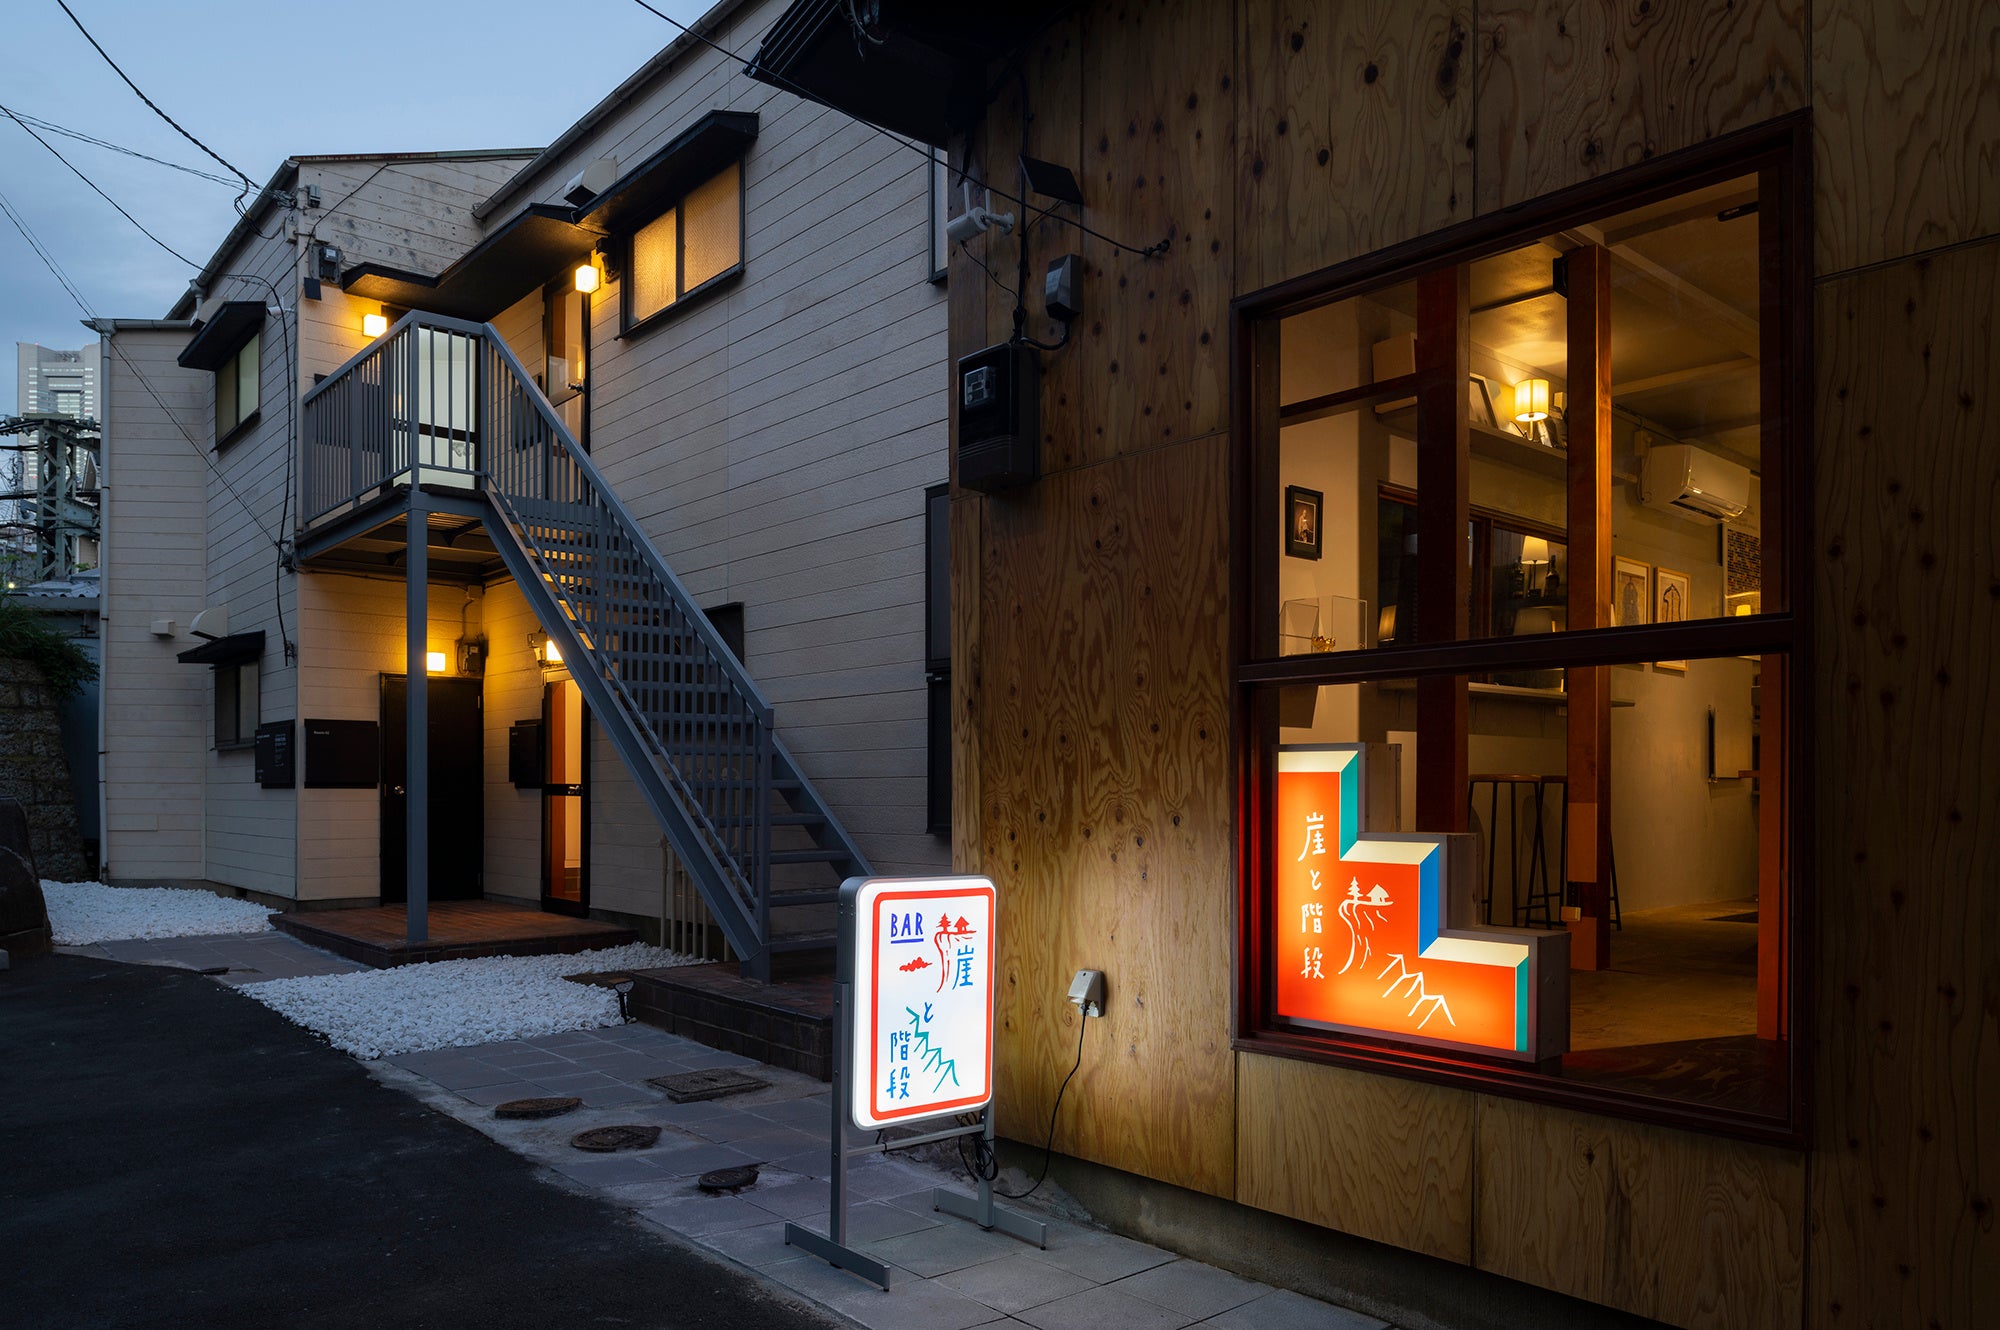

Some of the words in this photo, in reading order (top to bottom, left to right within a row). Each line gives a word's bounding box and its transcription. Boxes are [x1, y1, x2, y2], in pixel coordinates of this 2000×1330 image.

[891, 912, 924, 938] BAR
[1298, 812, 1326, 979] 崖と階段
